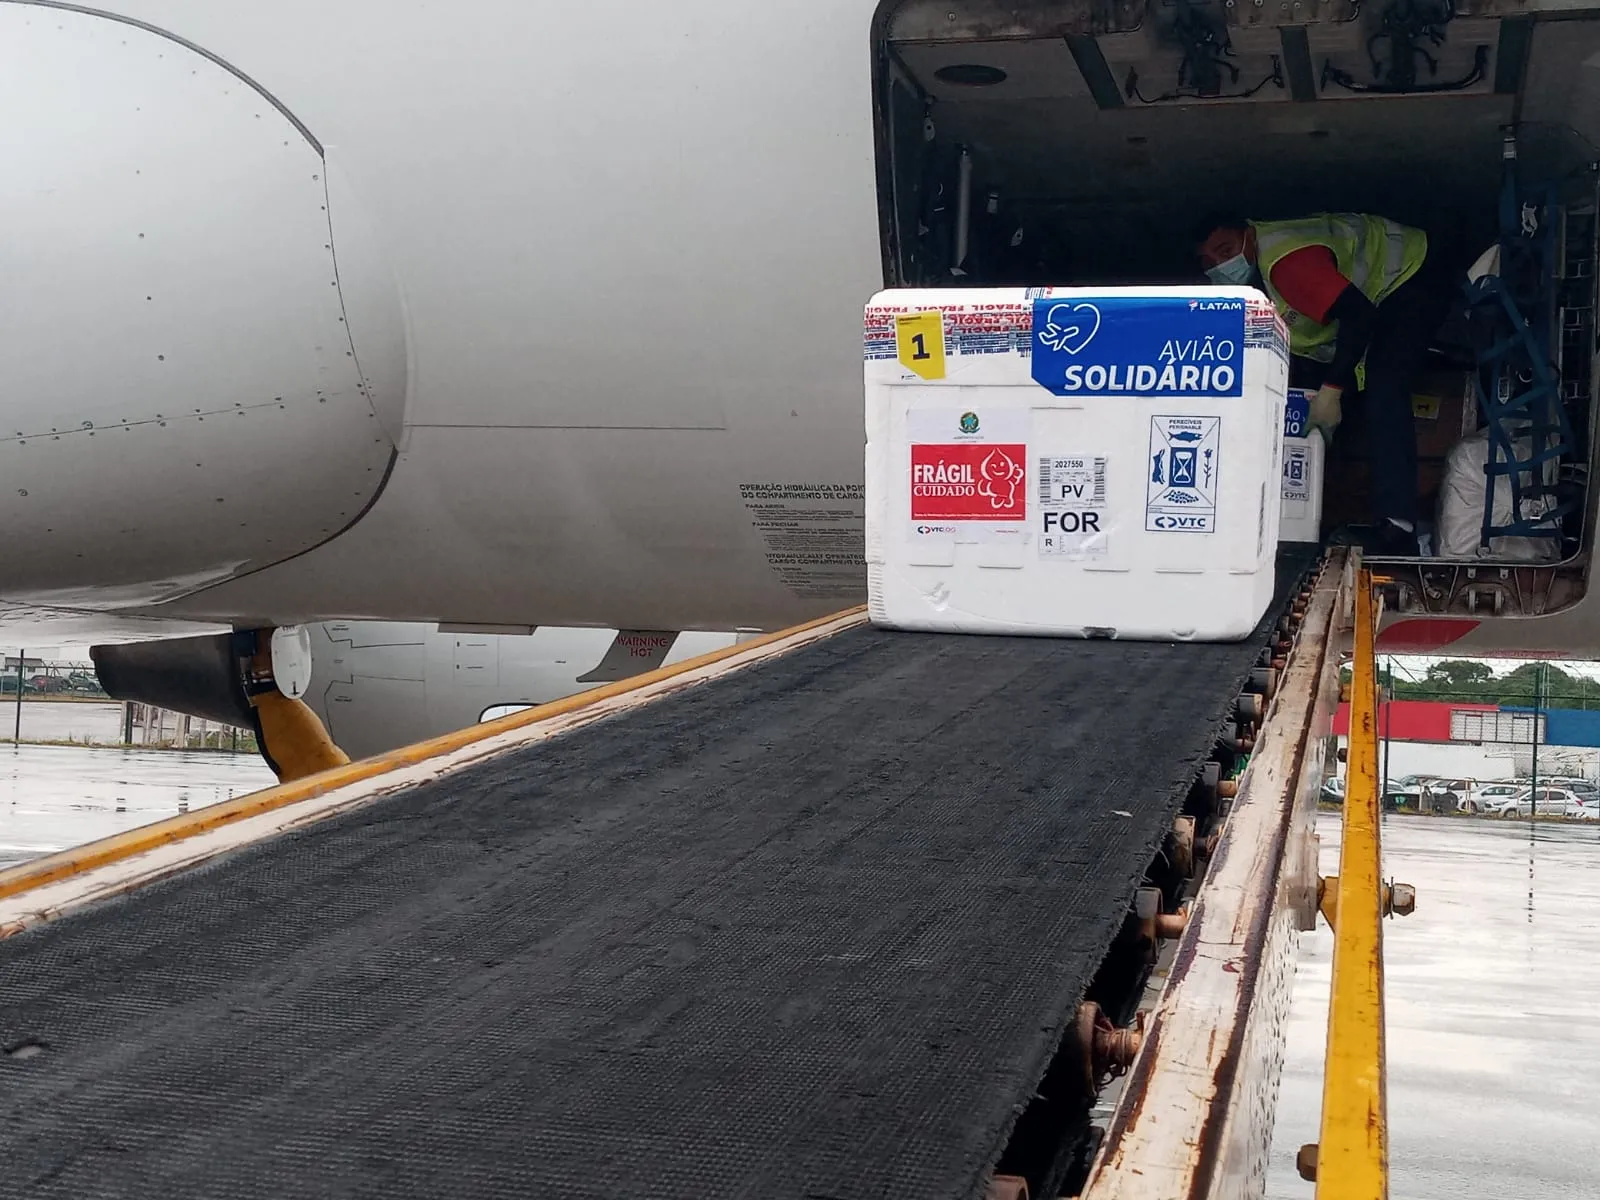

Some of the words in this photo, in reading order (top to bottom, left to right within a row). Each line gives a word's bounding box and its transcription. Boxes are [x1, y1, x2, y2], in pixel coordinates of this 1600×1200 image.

[1199, 302, 1242, 311] LATAM
[911, 333, 931, 361] 1
[1158, 336, 1234, 361] AVIÃO
[1064, 358, 1235, 392] SOLIDÁRIO
[1286, 407, 1301, 421] ÃO
[1054, 460, 1084, 469] 2027550
[913, 459, 975, 483] FRÁGIL
[739, 483, 783, 493] OPERAÇÃO
[833, 484, 846, 492] DA
[913, 485, 975, 497] CUIDADO
[1061, 484, 1084, 499] PV
[741, 491, 754, 499] DO
[1043, 511, 1101, 533] FOR
[1178, 517, 1206, 527] VTC
[1045, 538, 1053, 547] R
[616, 636, 668, 648] WARNING
[630, 648, 653, 657] HOT
